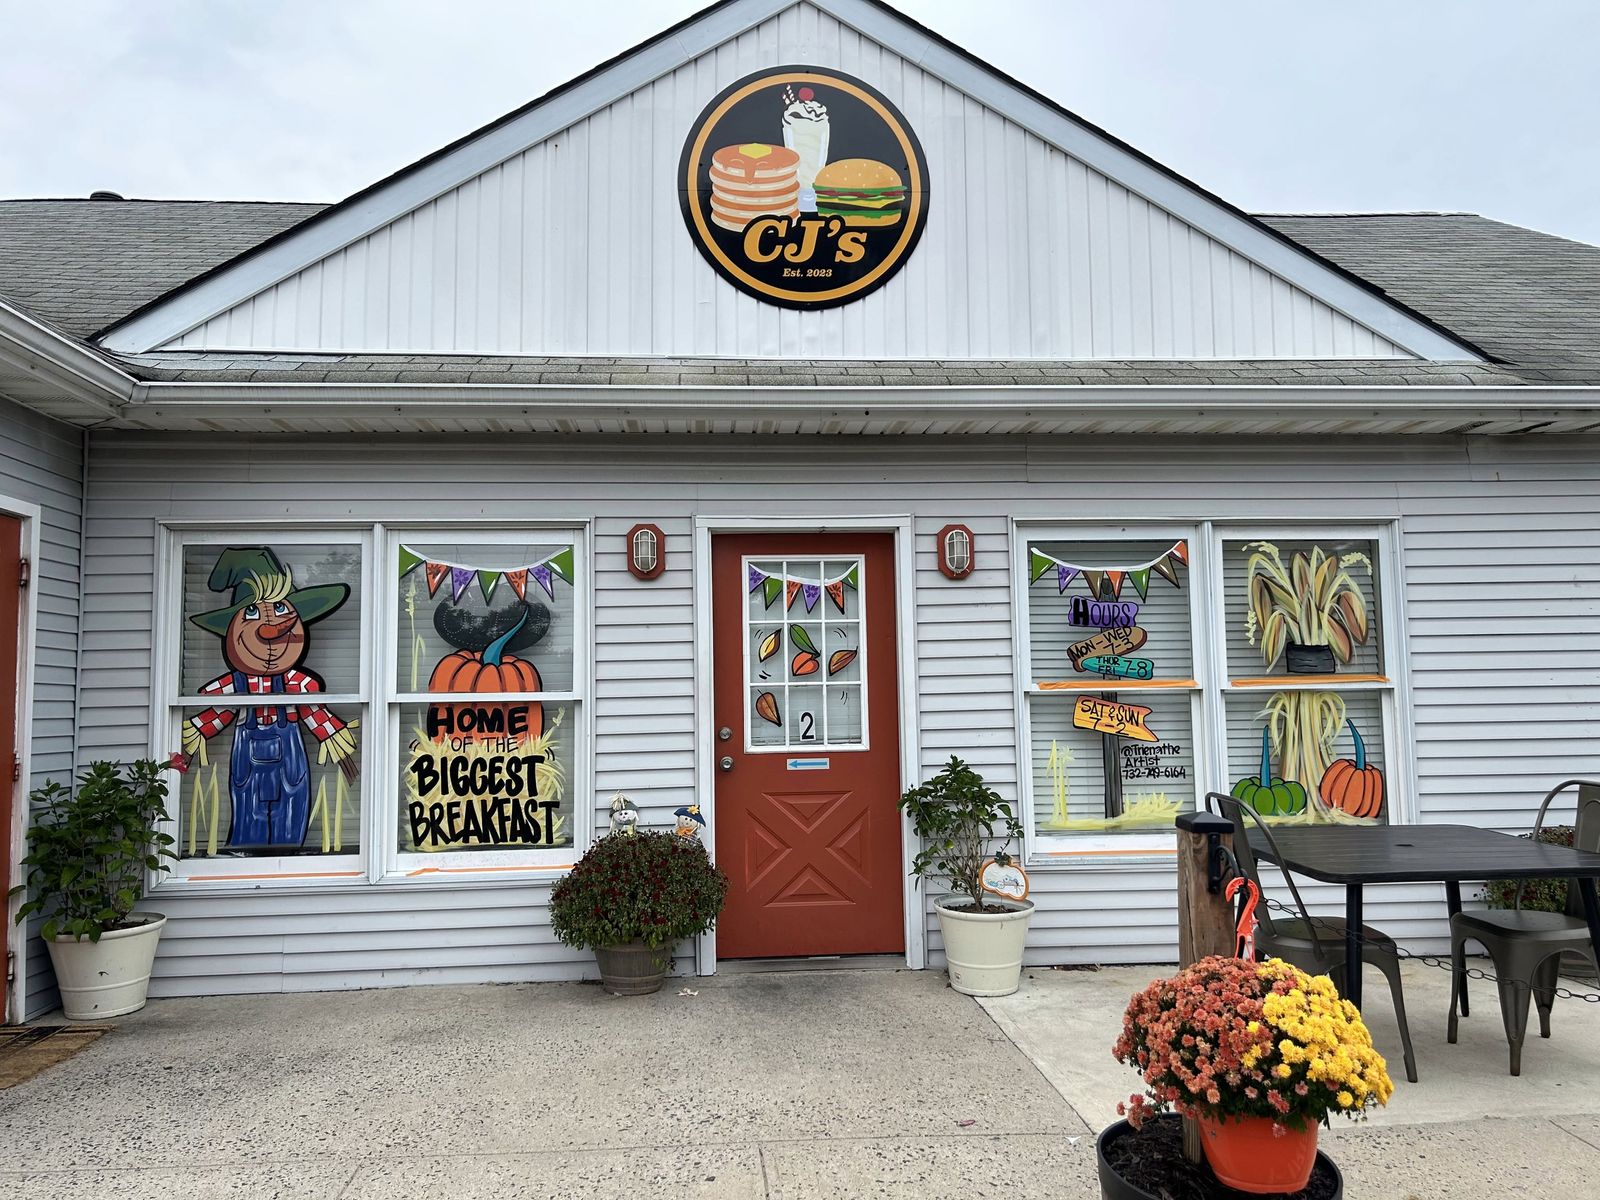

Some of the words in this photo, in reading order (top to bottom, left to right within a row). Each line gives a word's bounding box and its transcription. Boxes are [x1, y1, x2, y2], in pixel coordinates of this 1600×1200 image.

[744, 219, 868, 263] CJ's
[782, 268, 804, 277] Est.
[806, 268, 833, 277] 2023
[1073, 598, 1131, 627] HOURS
[1096, 656, 1120, 665] THUR
[1098, 665, 1116, 675] FRI
[428, 706, 528, 737] HOME
[801, 712, 815, 739] 2
[451, 736, 473, 753] OF
[481, 736, 519, 753] THE
[1124, 755, 1160, 768] Artist
[409, 797, 560, 846] BREAKFAST
